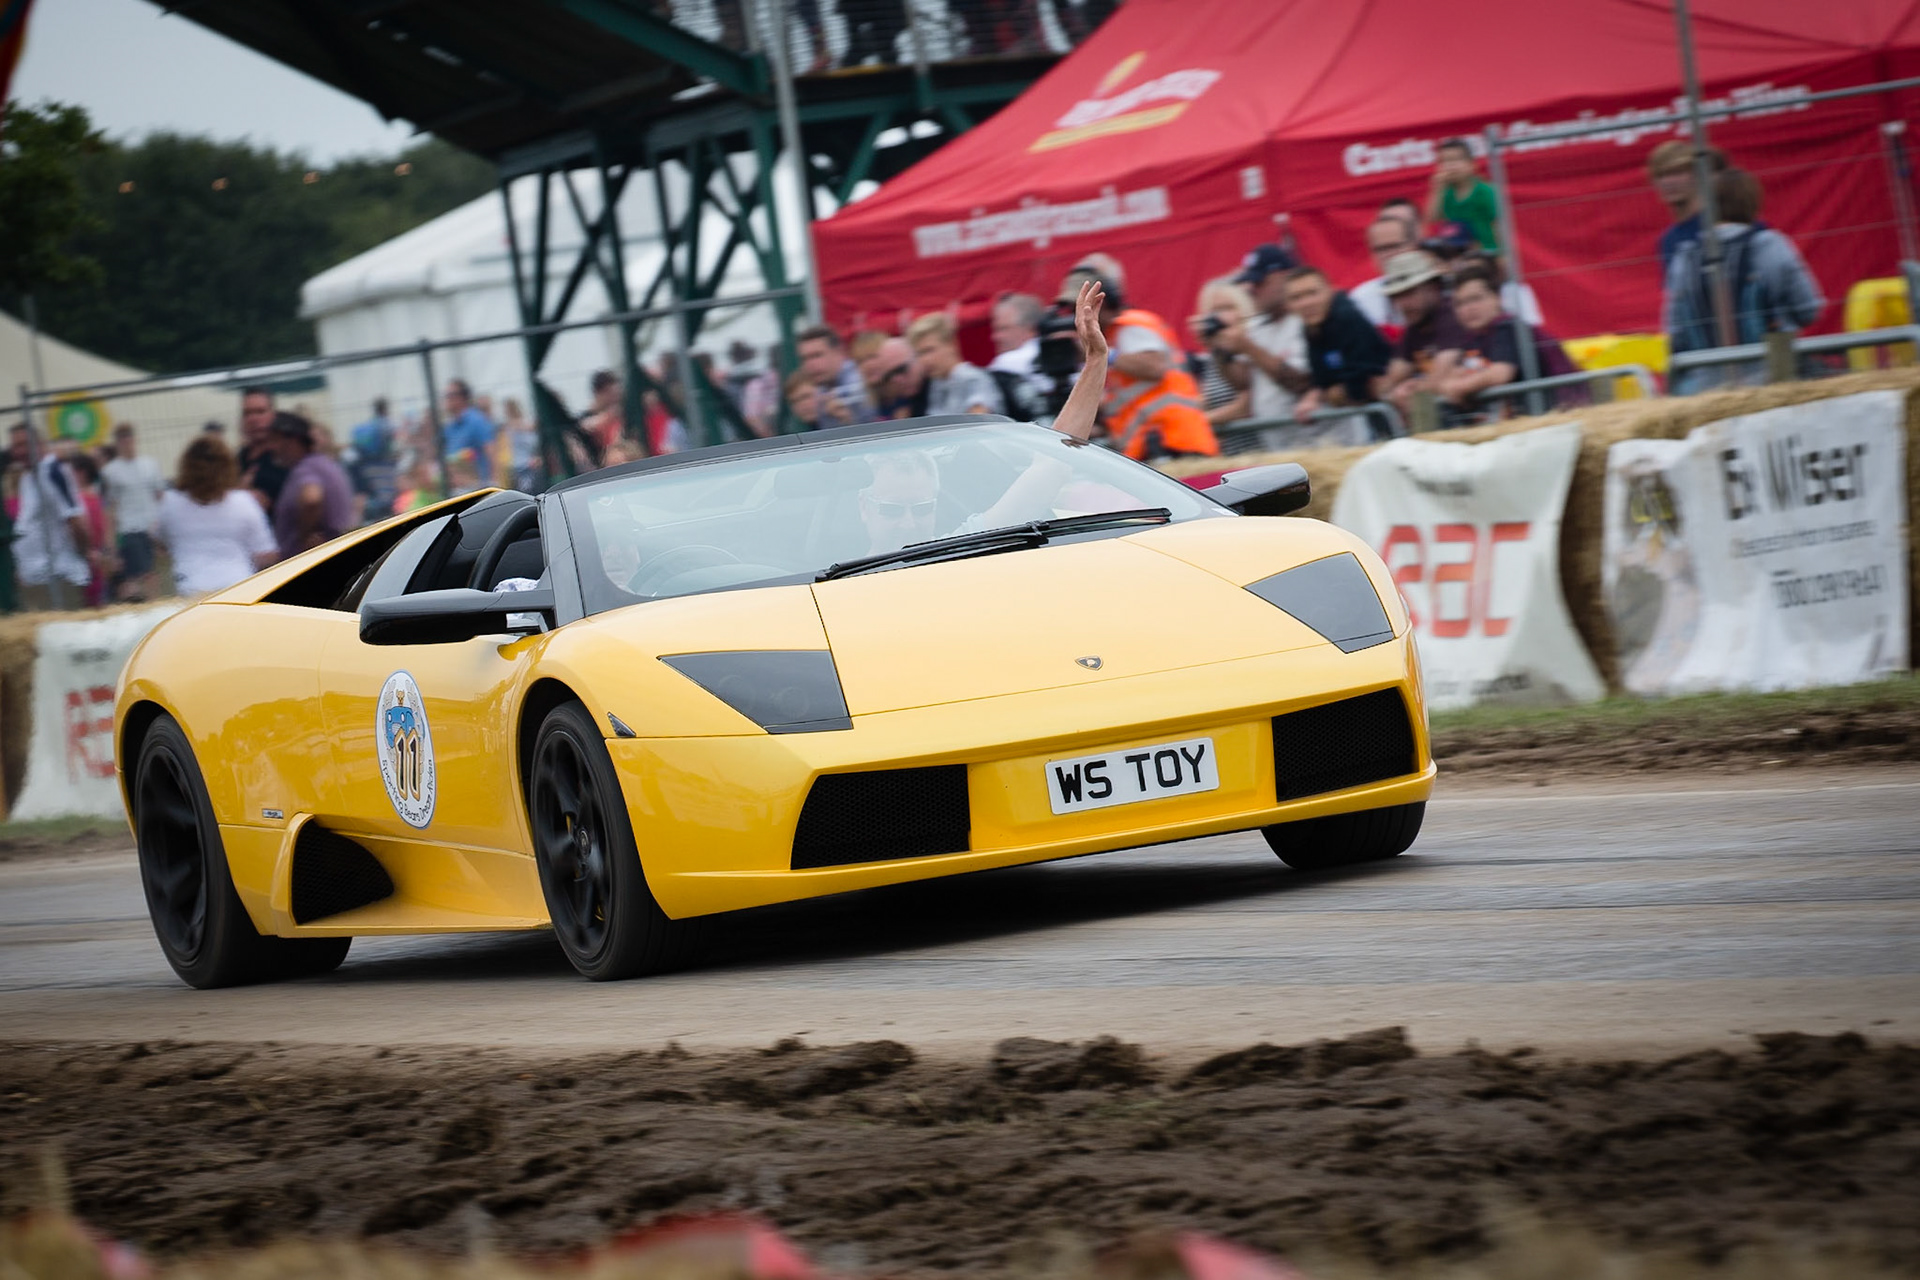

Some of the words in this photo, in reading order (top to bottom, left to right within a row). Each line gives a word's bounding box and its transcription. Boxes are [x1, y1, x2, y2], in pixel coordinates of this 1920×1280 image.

[394, 727, 420, 801] 11
[1055, 760, 1113, 804] WS
[1125, 744, 1205, 792] TOY
[404, 803, 421, 822] Bears
